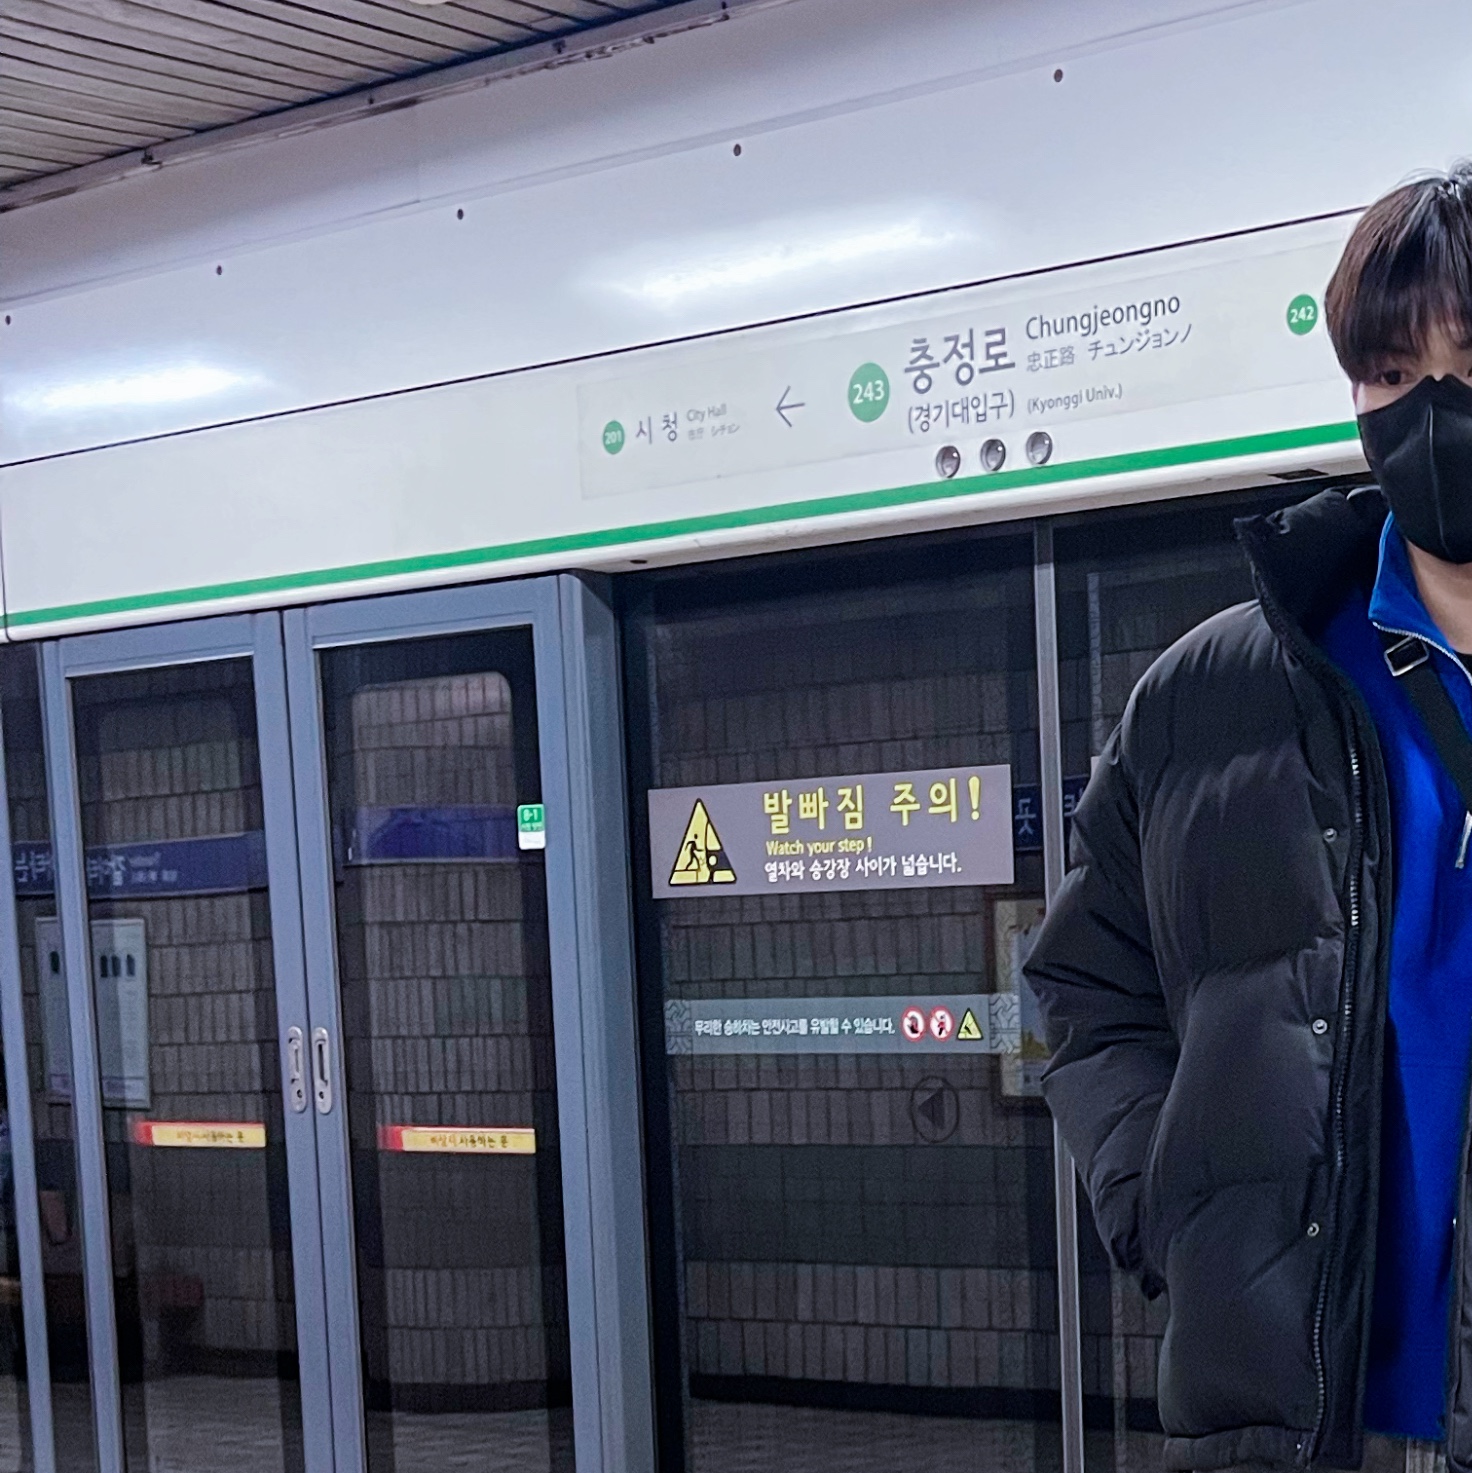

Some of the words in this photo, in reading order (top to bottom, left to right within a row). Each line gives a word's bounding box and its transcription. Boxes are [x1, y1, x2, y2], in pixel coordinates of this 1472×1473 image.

[1025, 295, 1181, 341] Chungjeongno
[1290, 305, 1314, 323] 242
[1087, 323, 1193, 362] チュンジョンノ
[904, 327, 1016, 394] 충정로
[1026, 346, 1075, 372] 忠正路
[853, 379, 885, 404] 243
[1085, 383, 1123, 405] Univ.)
[707, 403, 727, 418] Hall
[908, 389, 1015, 433] (경기대입구)
[604, 430, 623, 445] 201
[763, 784, 865, 834] 발빠짐
[889, 775, 981, 827] 주의!
[766, 839, 804, 856] Watch
[807, 840, 836, 857] your
[764, 860, 805, 882] 열차와
[809, 857, 851, 881] 승강장
[855, 854, 897, 877] 사이가
[902, 851, 962, 877] 넓습니다.
[841, 1018, 852, 1035] 수
[853, 1017, 896, 1035] 있습니다.
